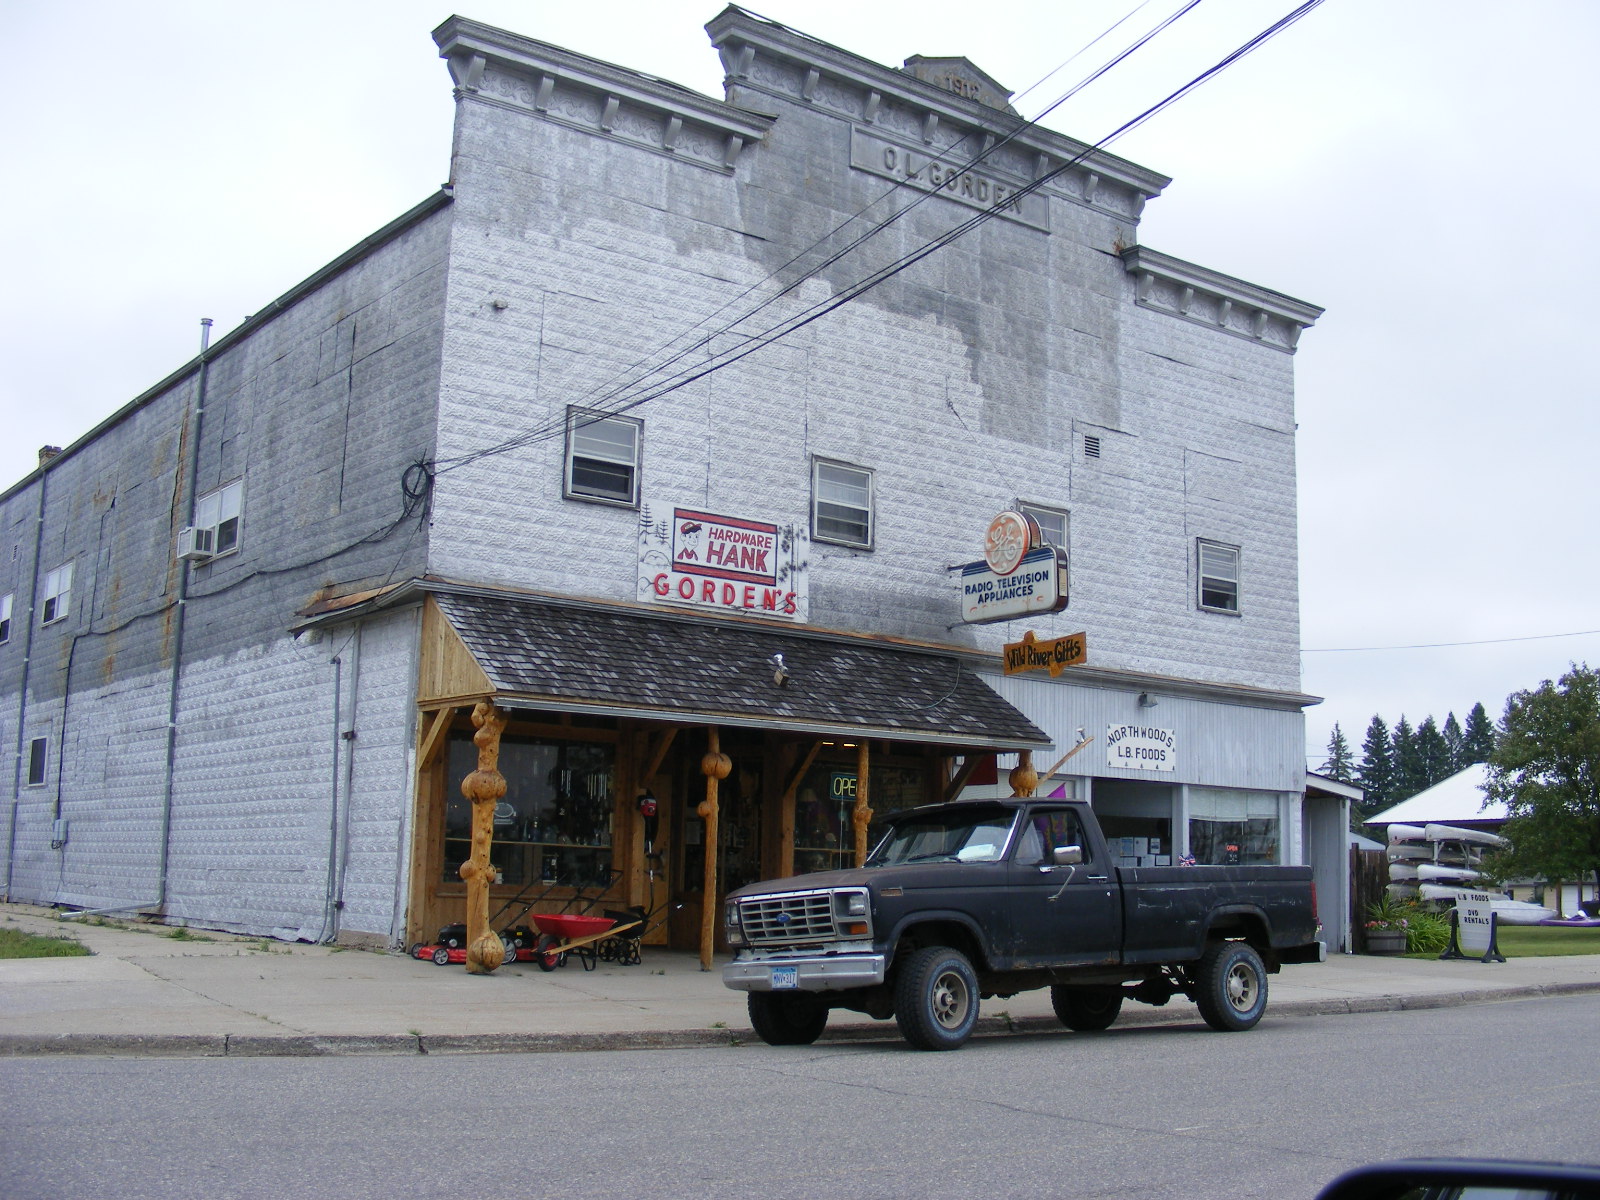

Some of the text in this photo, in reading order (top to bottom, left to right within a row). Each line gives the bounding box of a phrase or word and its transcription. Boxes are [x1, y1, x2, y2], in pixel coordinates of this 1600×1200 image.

[929, 162, 1023, 214] GORDEN
[708, 527, 773, 549] HARDWARE
[706, 541, 769, 573] HANK
[653, 573, 797, 614] GORDEN'S
[965, 570, 1049, 595] RADIO TELEVISION
[977, 585, 1034, 604] APPLIANCES
[1007, 639, 1082, 671] Wild River Gifts
[1135, 747, 1166, 761] FOODS
[833, 777, 858, 797] OPE
[1471, 894, 1489, 902] FOODS
[1464, 917, 1489, 925] RENTALS
